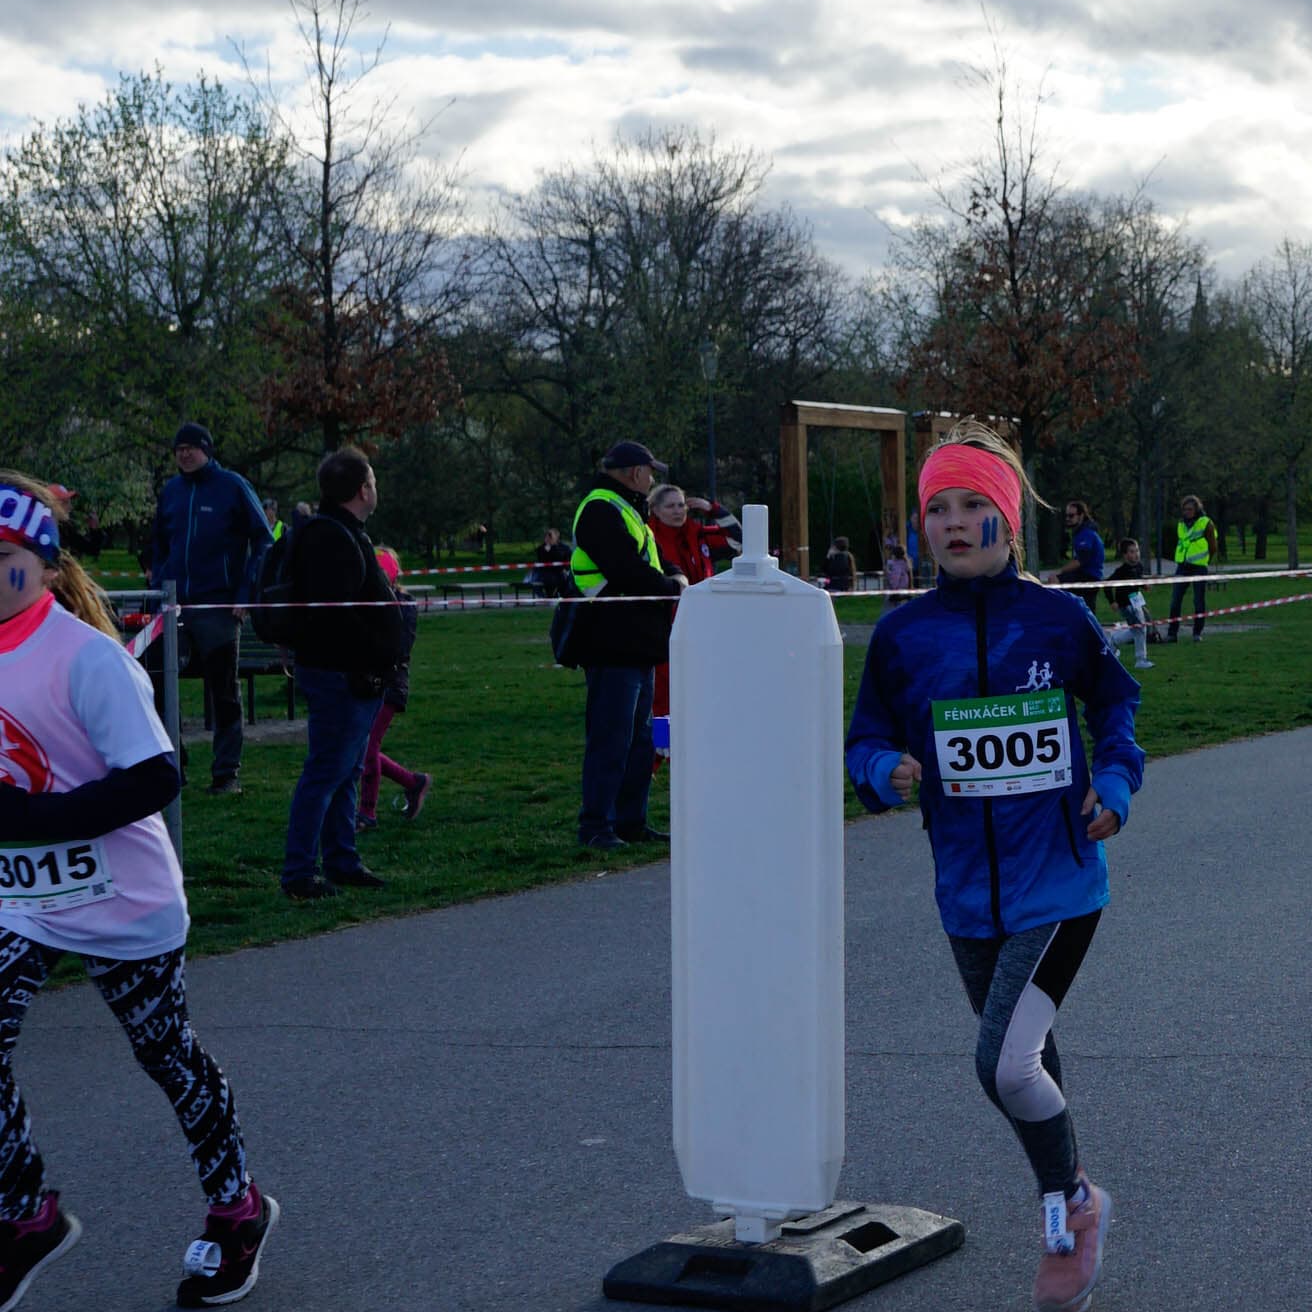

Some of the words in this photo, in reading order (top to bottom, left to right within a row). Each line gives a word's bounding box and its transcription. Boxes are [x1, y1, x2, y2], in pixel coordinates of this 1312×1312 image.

[944, 703, 1017, 721] FÉNIXÁČEK
[947, 727, 1061, 772] 3005
[0, 844, 97, 889] 3015
[1050, 1206, 1060, 1235] 3005
